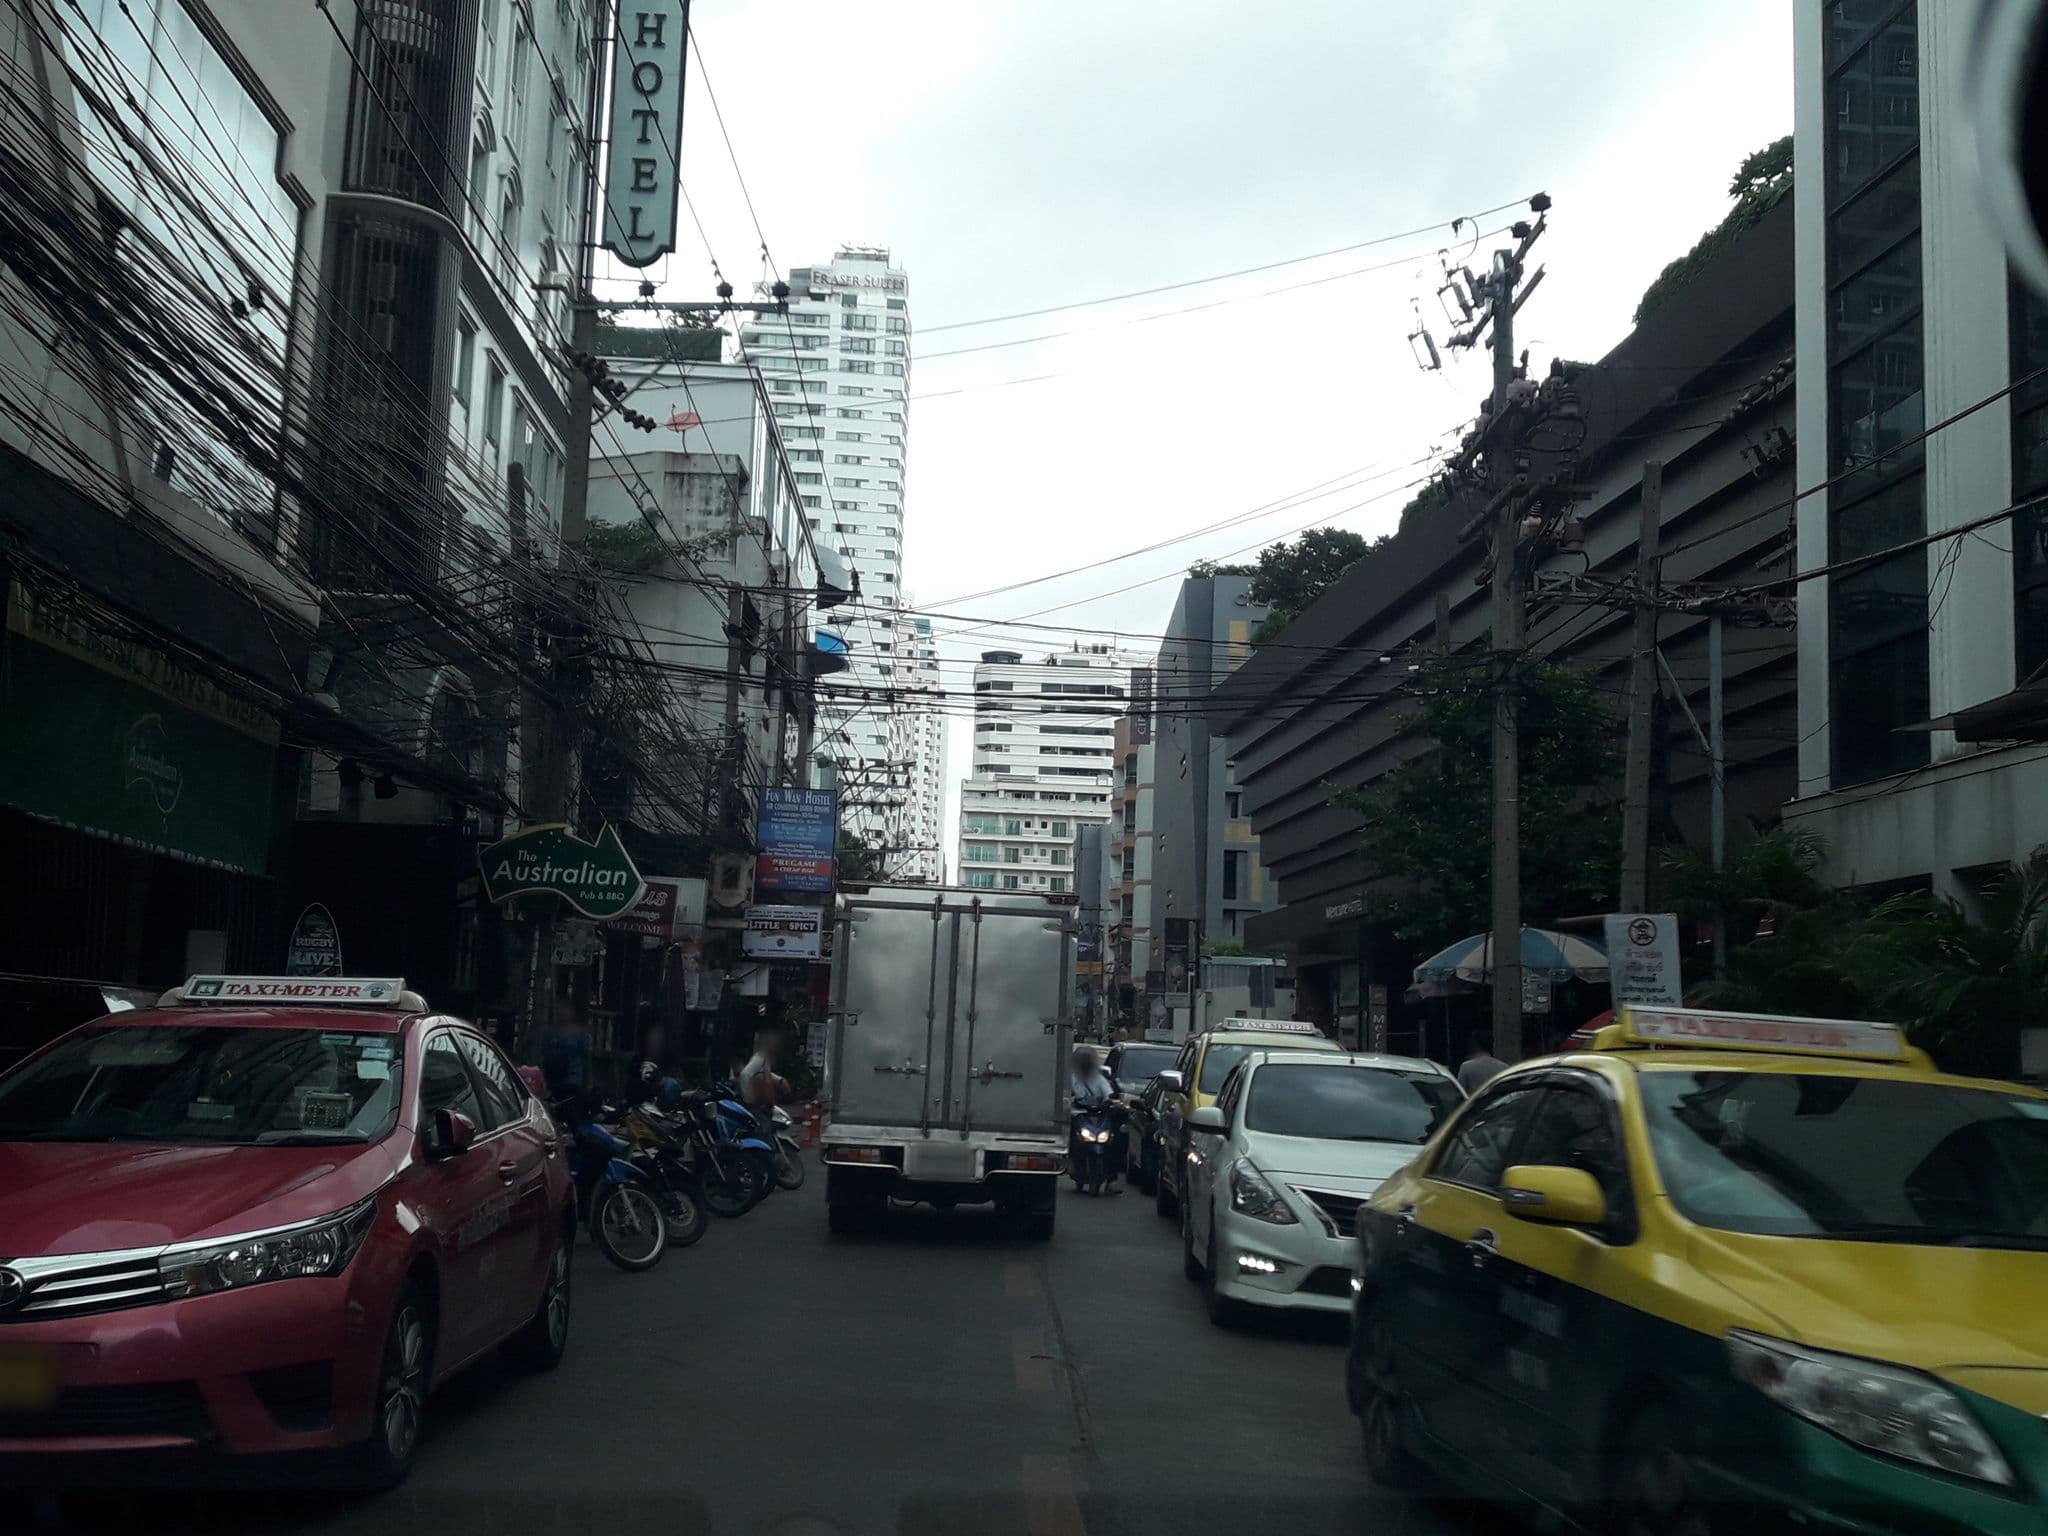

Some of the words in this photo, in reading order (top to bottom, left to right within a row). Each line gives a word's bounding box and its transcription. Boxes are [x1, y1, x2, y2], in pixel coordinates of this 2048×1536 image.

[628, 13, 667, 241] HOTEL
[813, 271, 862, 287] FRASER
[864, 274, 905, 290] SUITES
[517, 850, 537, 862] The
[492, 859, 628, 886] Australian
[580, 890, 595, 900] Pub
[597, 891, 603, 900] &
[606, 892, 625, 901] BBQ
[749, 920, 780, 930] LITTLE
[789, 922, 816, 931] SPICY
[295, 937, 336, 948] RUGBY
[225, 983, 362, 997] TAXI-METER
[1372, 1014, 1385, 1054] Merc
